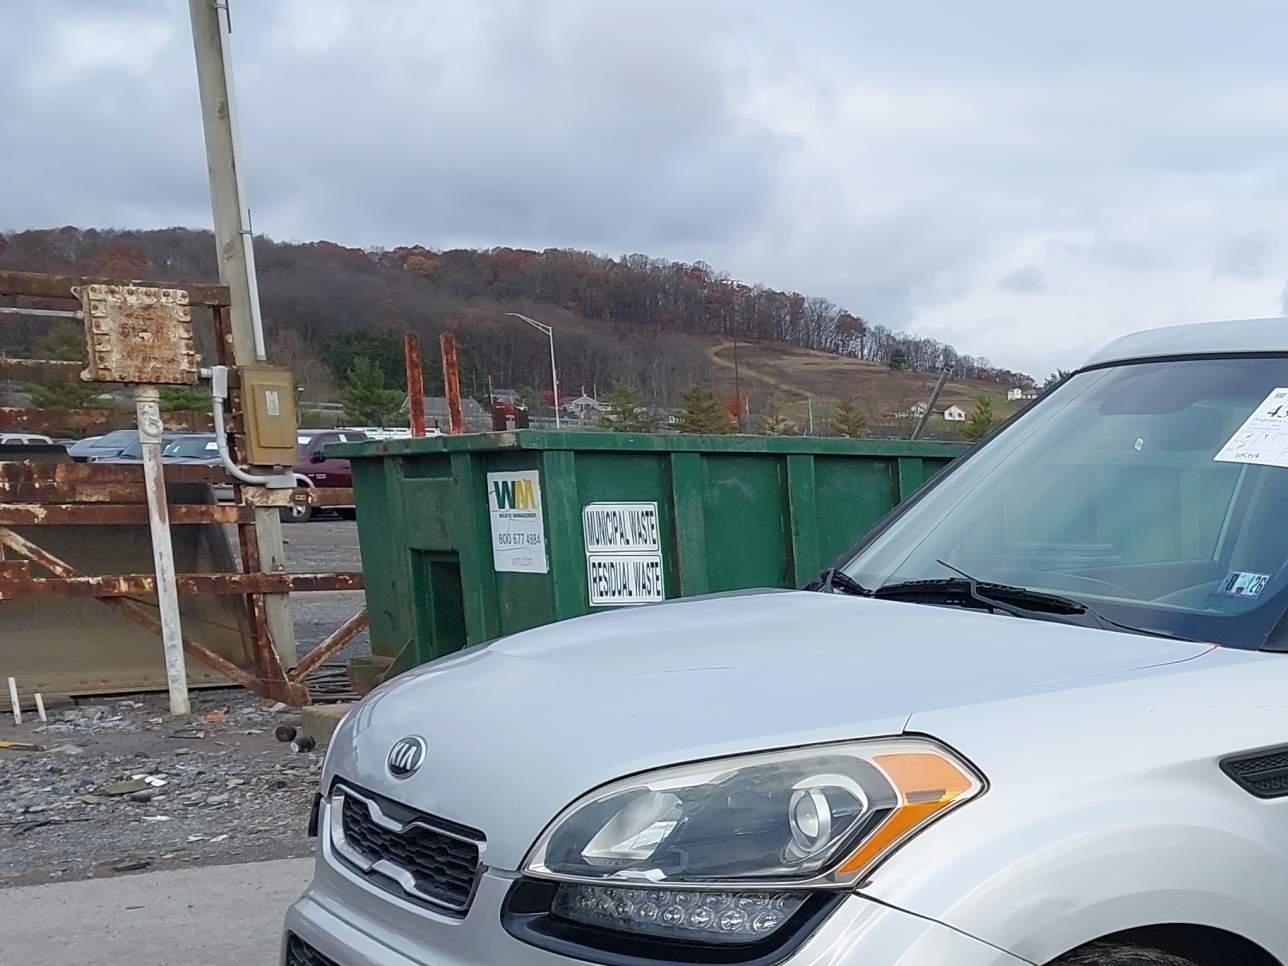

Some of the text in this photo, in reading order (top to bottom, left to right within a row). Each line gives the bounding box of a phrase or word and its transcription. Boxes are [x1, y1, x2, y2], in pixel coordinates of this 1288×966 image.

[493, 480, 537, 509] WM
[512, 533, 525, 545] 677
[586, 510, 656, 545] MUNICIPAL WASTE
[592, 562, 660, 597] RESIDUAL WASTE
